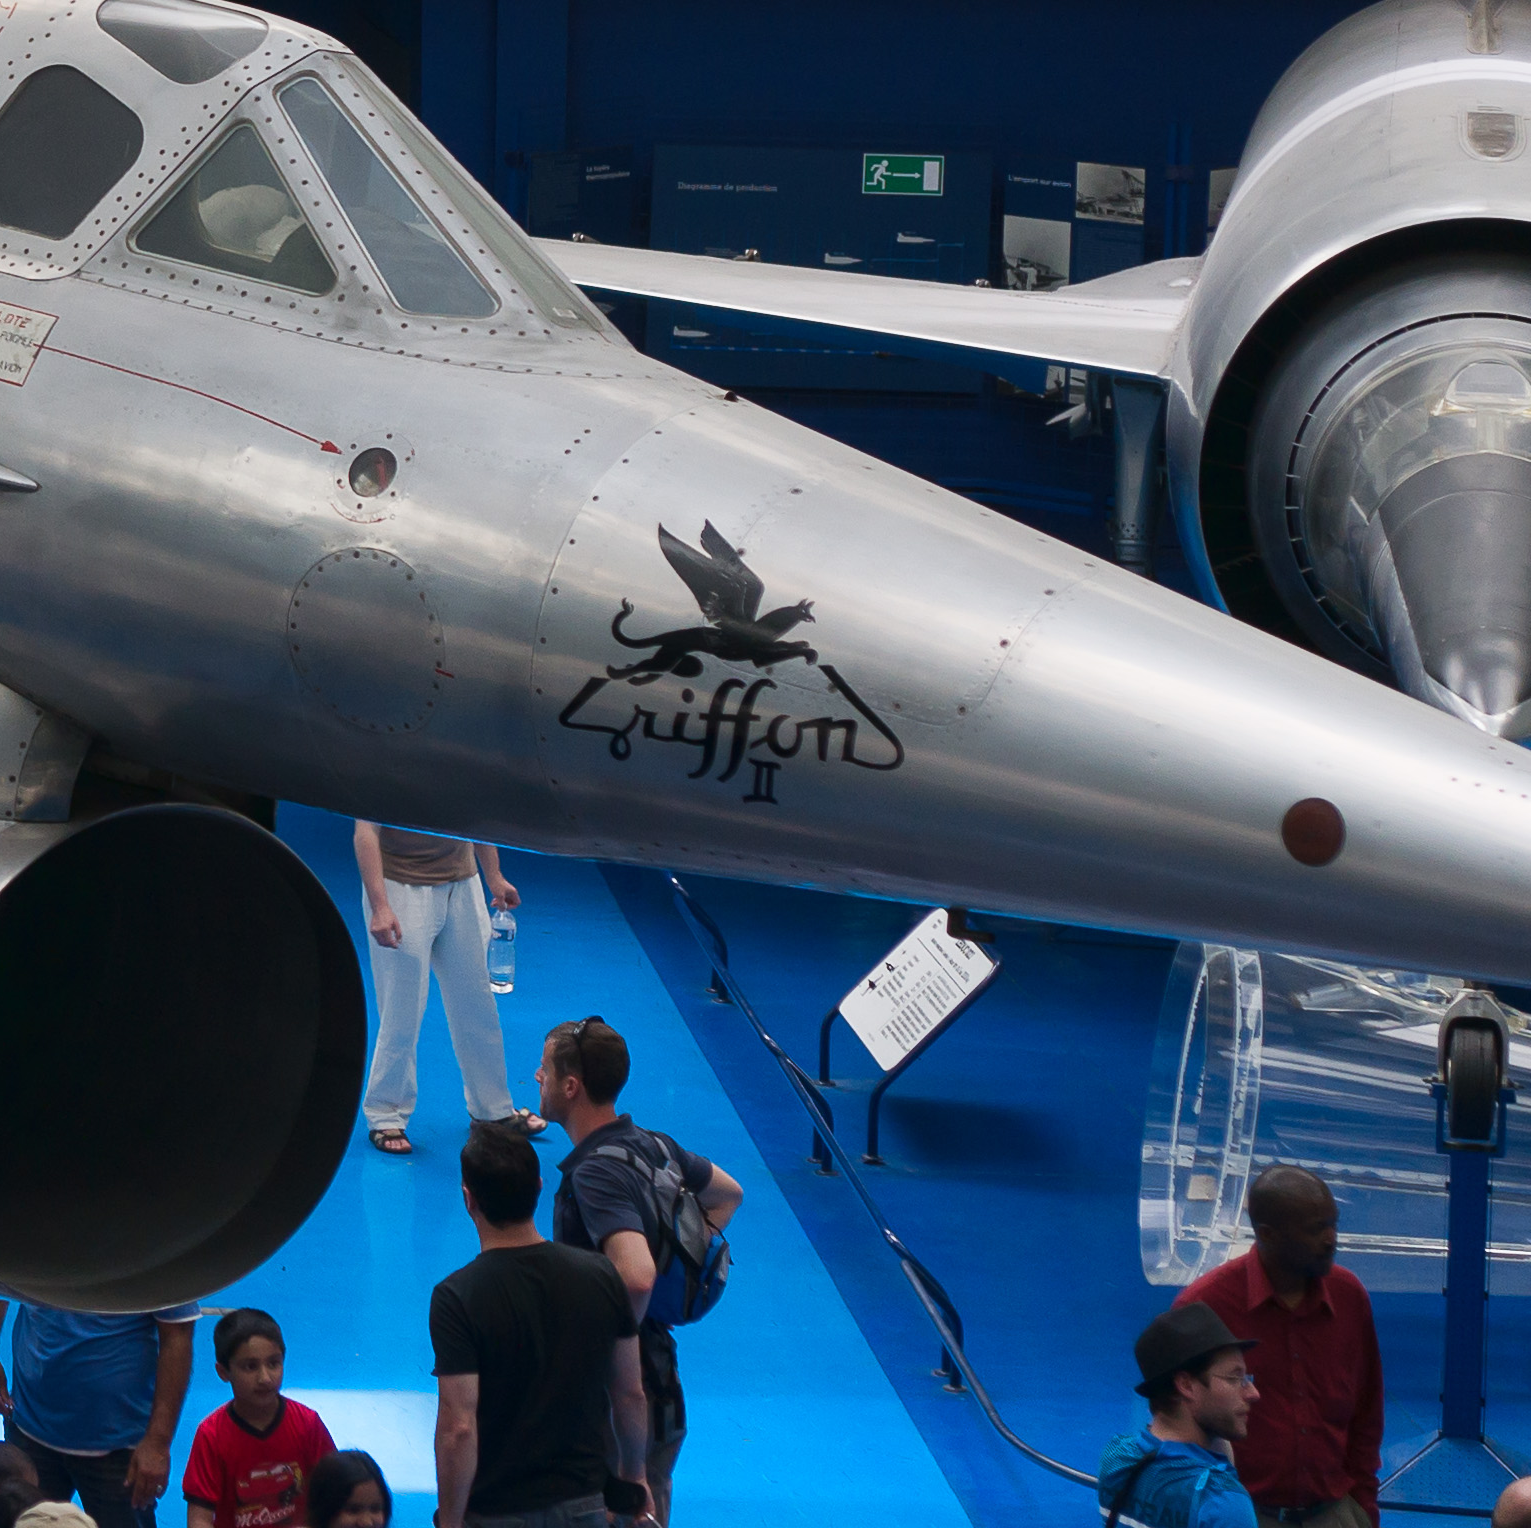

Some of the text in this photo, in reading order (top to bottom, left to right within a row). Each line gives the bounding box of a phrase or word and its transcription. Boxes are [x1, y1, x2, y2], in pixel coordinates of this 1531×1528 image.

[723, 182, 734, 190] de
[559, 664, 905, 783] Griffon
[742, 757, 782, 805] II
